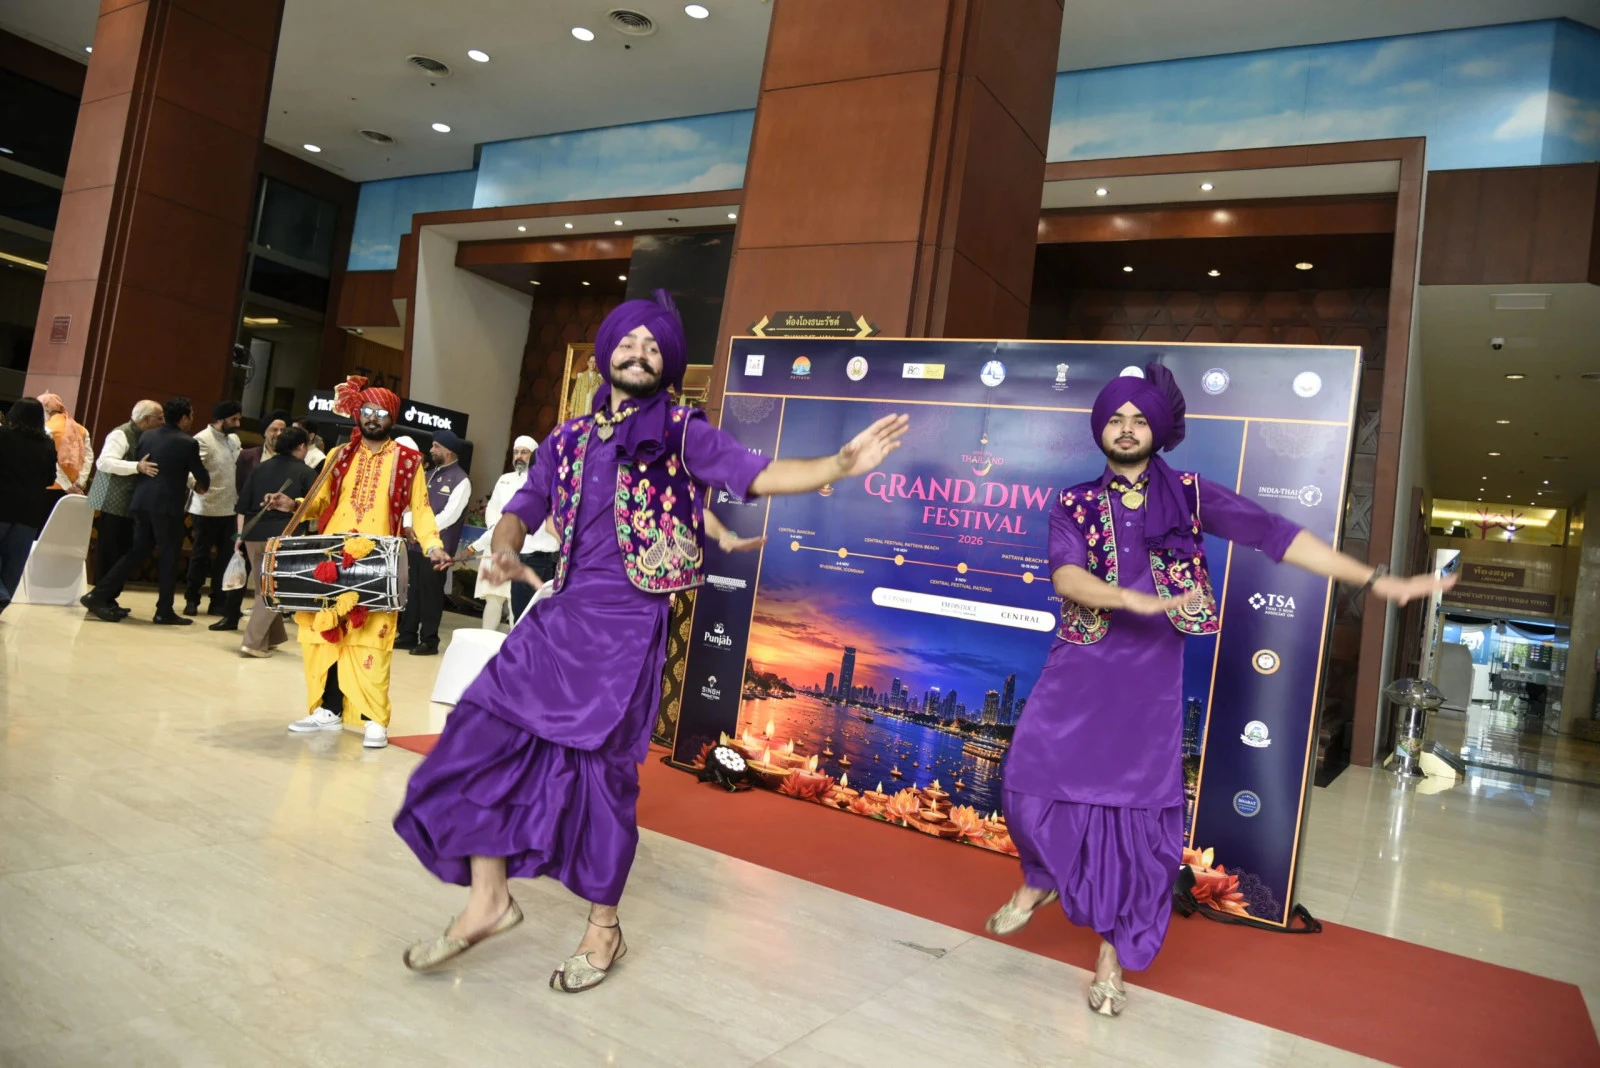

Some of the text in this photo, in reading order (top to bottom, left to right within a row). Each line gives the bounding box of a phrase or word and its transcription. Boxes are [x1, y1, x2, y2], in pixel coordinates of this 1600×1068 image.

[317, 398, 335, 412] TikT
[416, 411, 451, 430] TikTok
[961, 454, 1005, 466] THAILAND
[864, 471, 1054, 512] GRAND DIW
[1258, 486, 1298, 496] INDIA-THAI
[922, 506, 1027, 535] FESTIVAL
[864, 537, 884, 545] CENTRAL
[904, 541, 923, 549] PATTAYA
[924, 543, 940, 551] BEACH
[958, 534, 984, 546] 2026
[1024, 556, 1043, 564] BEACH
[929, 579, 993, 593] CENTRAL FESTIVAL PATONG
[1266, 593, 1296, 610] TSA
[1001, 611, 1041, 624] CENTRAL
[1264, 610, 1295, 618] ASSOCIATON
